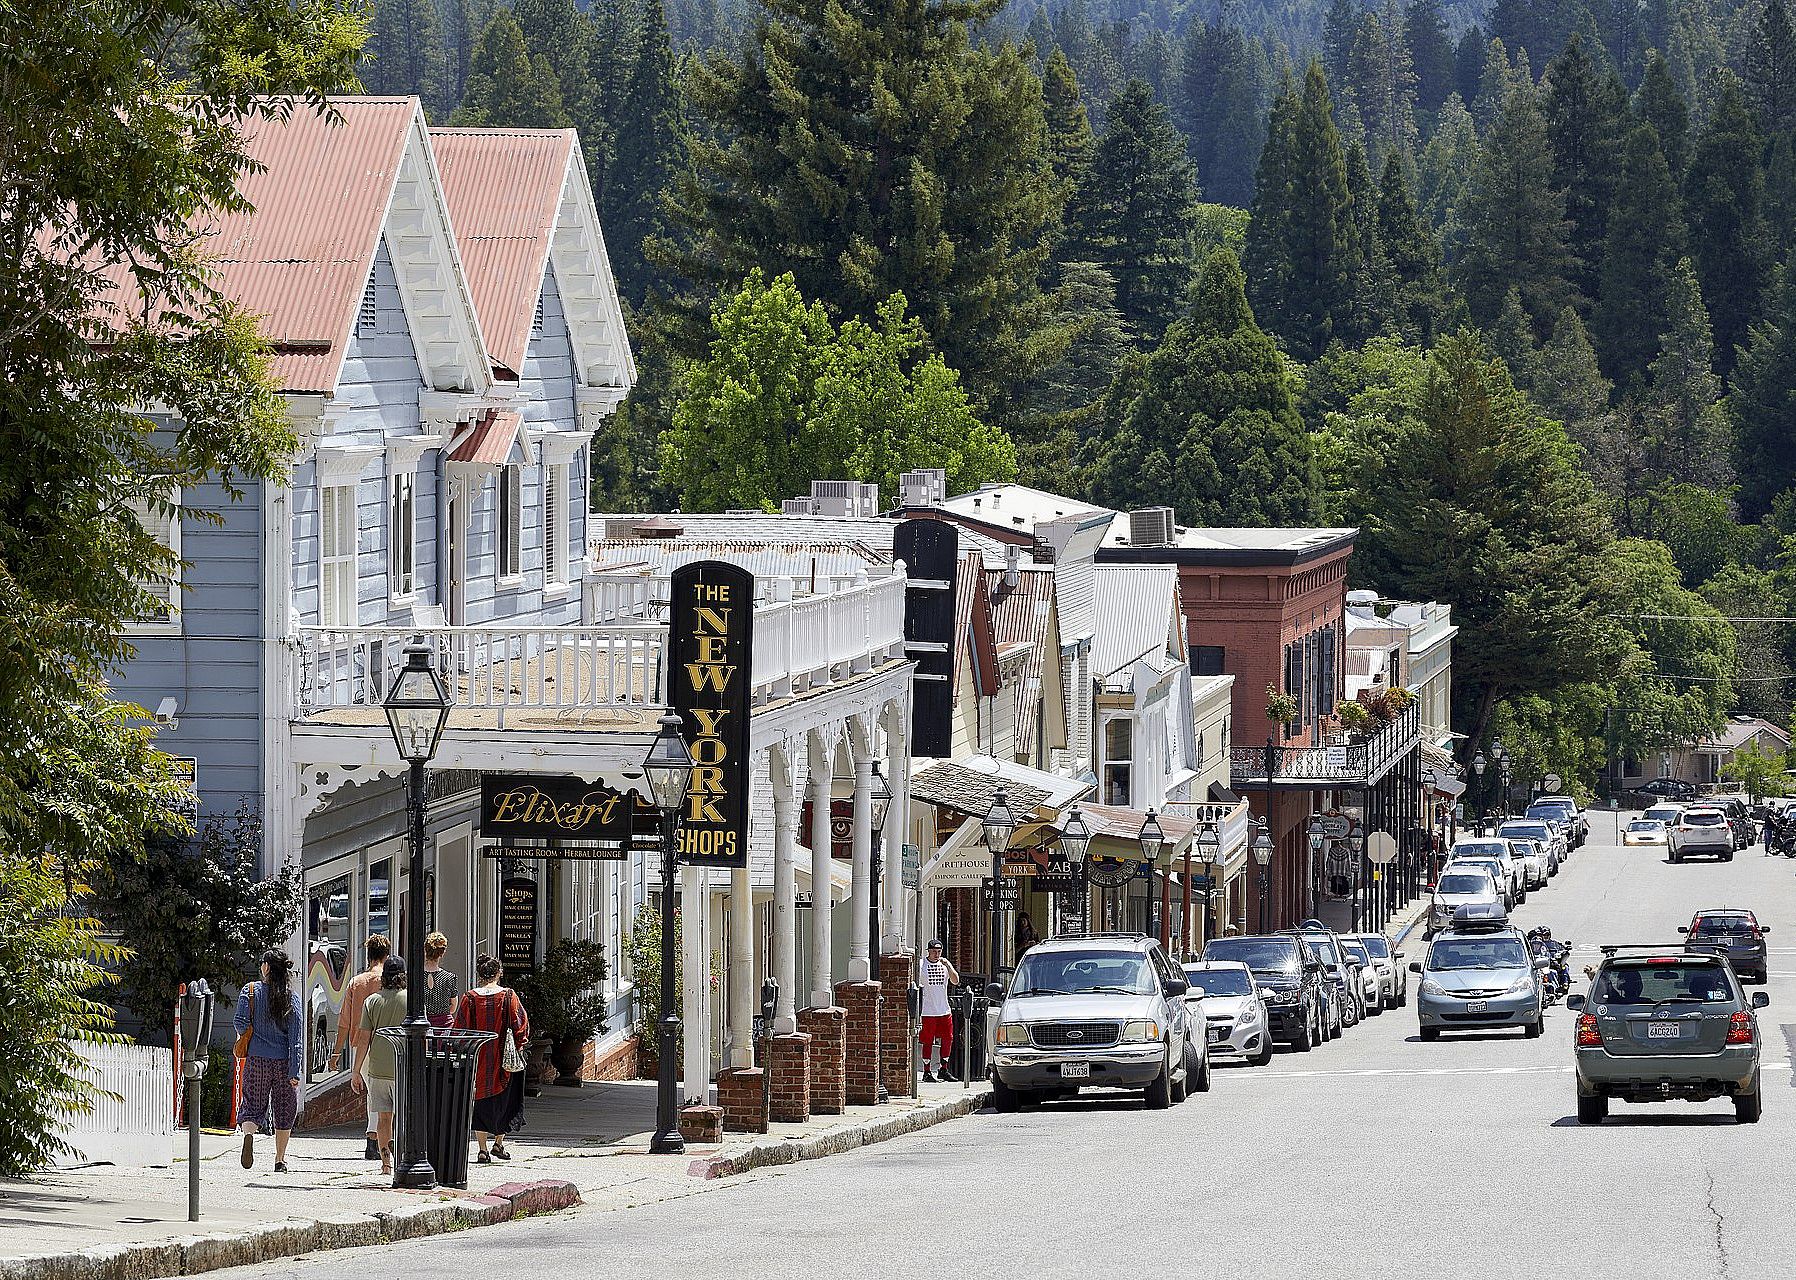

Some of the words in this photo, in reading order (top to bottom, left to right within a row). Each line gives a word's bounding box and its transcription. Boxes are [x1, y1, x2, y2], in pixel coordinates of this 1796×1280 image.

[694, 584, 730, 602] THE
[684, 607, 738, 693] NEW
[686, 708, 731, 823] YORK
[490, 785, 621, 831] Elixart
[677, 828, 737, 856] SHOPS
[489, 847, 502, 856] ART
[504, 848, 534, 857] TASTING
[535, 849, 558, 857] ROOM
[564, 850, 591, 858] HERBAL
[592, 849, 622, 858] LOUNGE
[1005, 851, 1026, 859] BOS
[1008, 865, 1028, 875] YORK
[1006, 878, 1017, 888] TO
[504, 888, 533, 899] Shops
[985, 889, 1018, 899] PAKING
[989, 900, 1014, 910] SOPS
